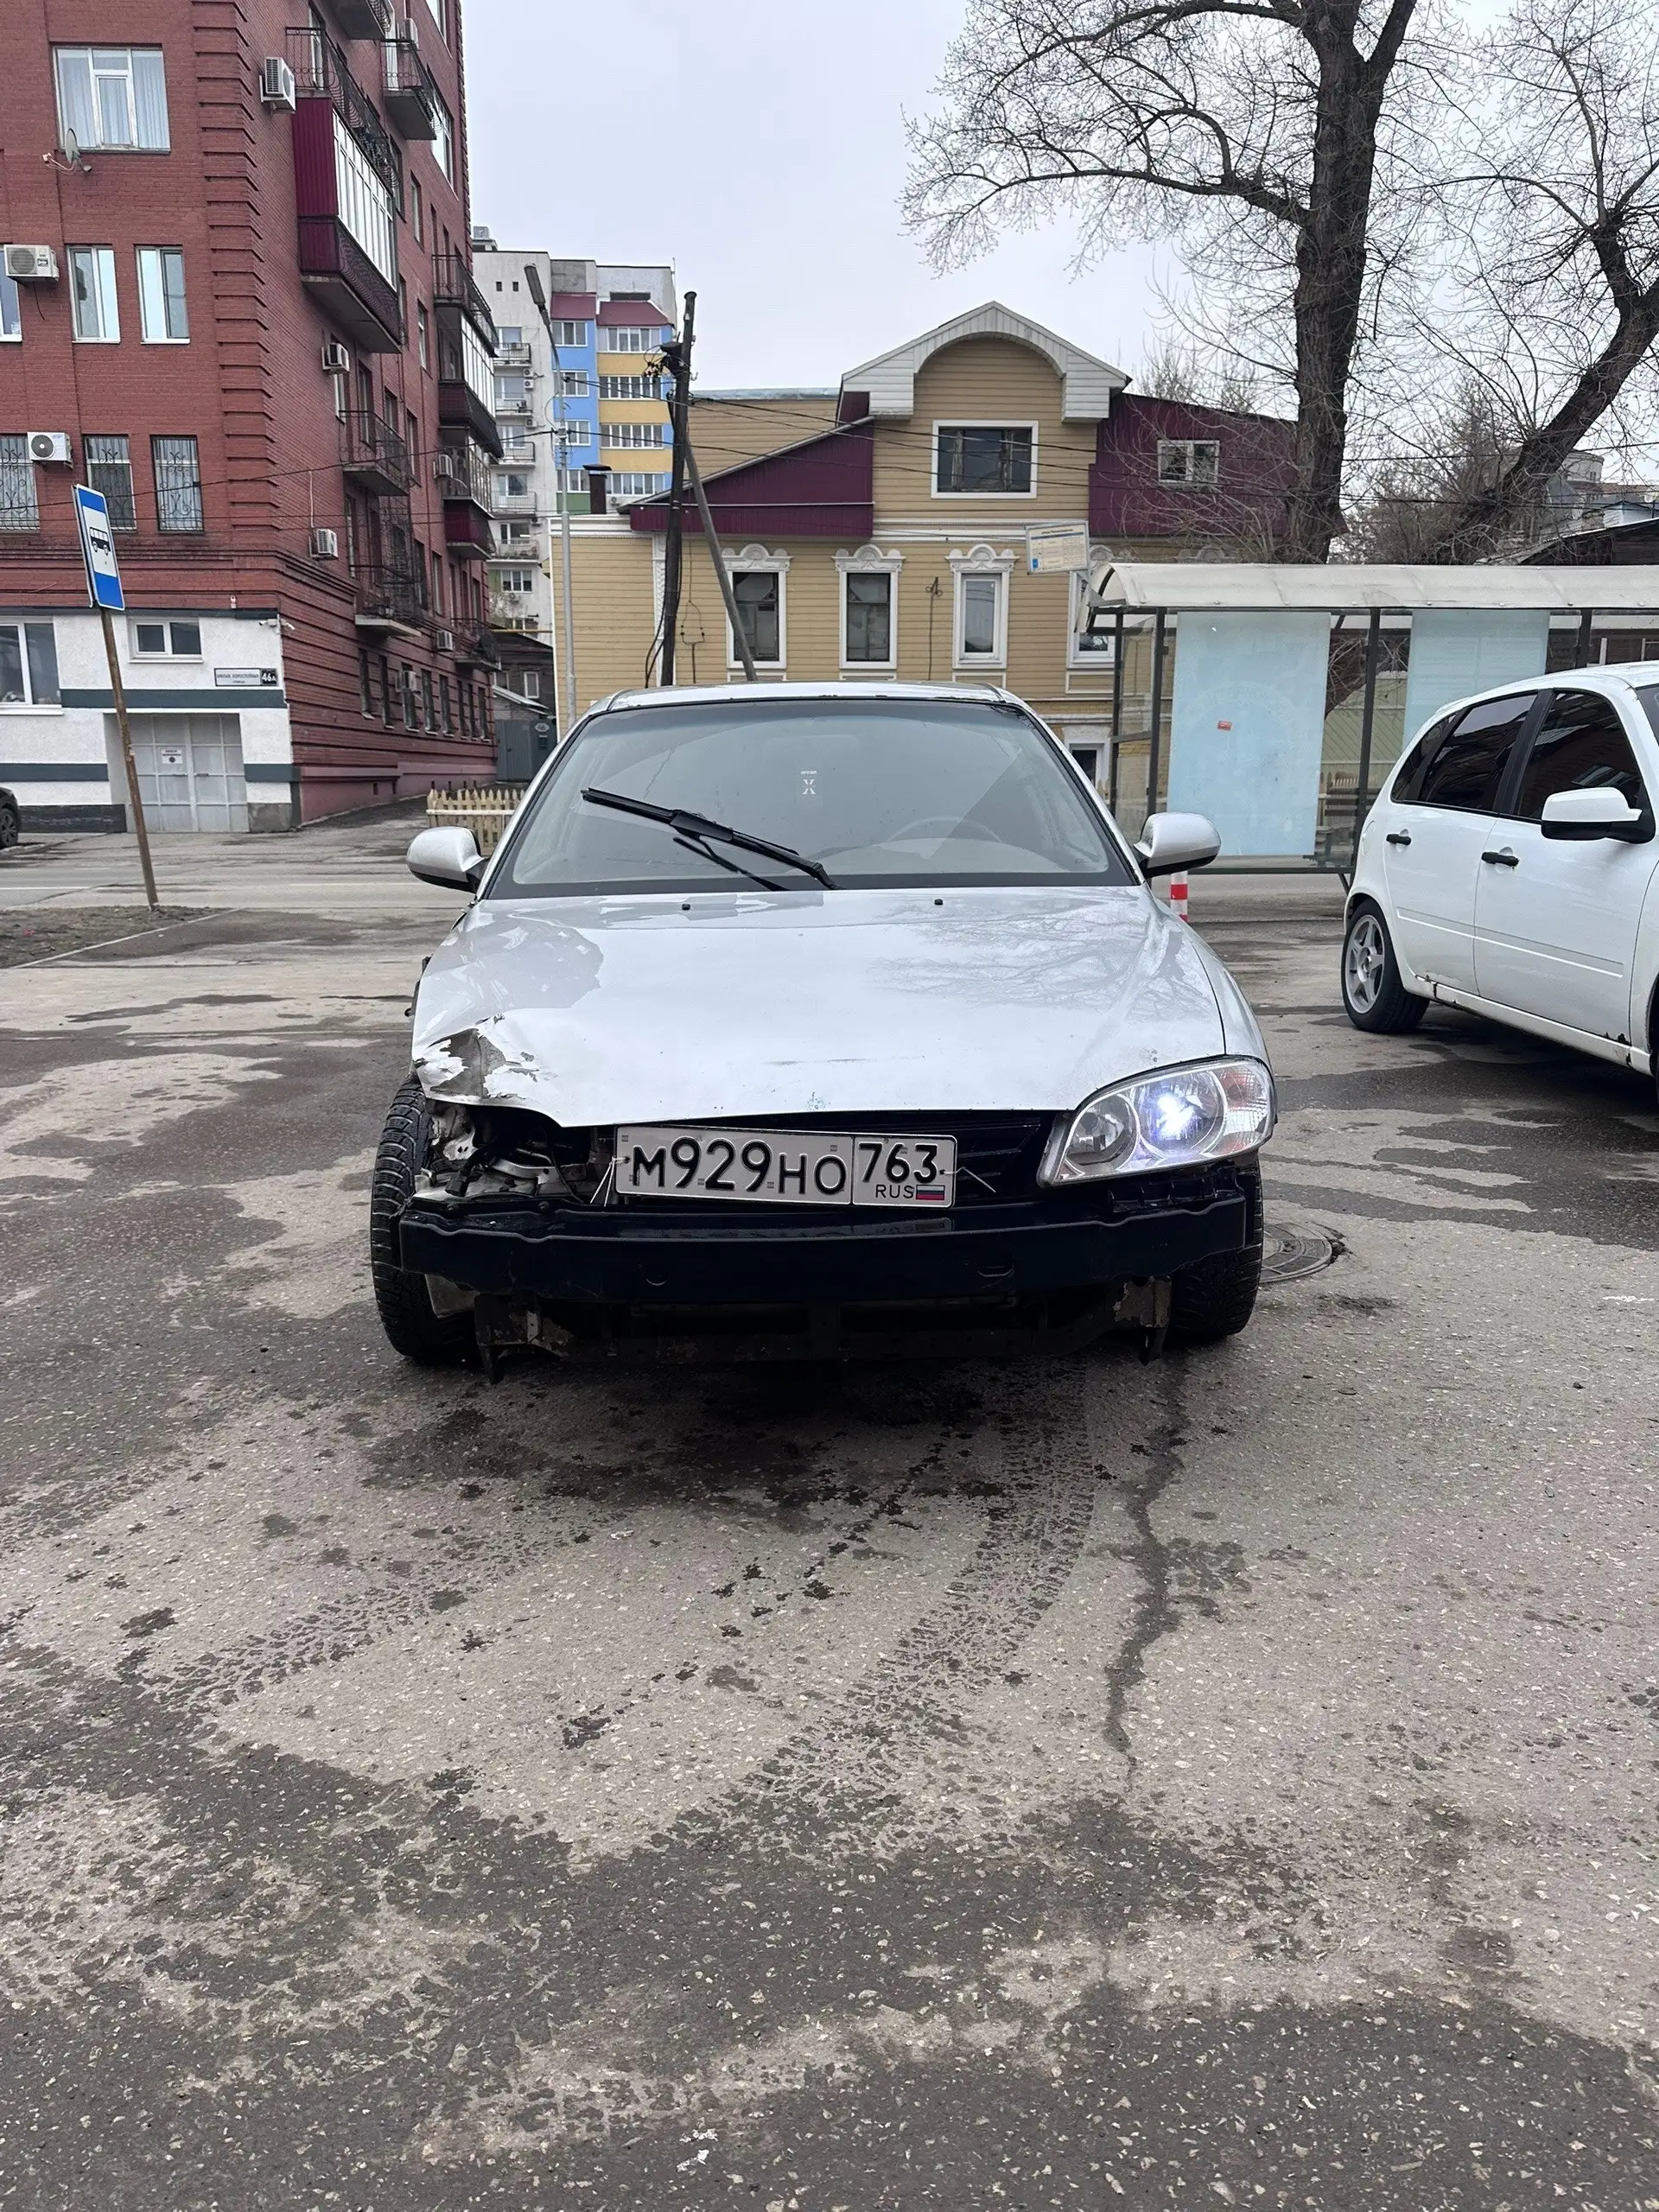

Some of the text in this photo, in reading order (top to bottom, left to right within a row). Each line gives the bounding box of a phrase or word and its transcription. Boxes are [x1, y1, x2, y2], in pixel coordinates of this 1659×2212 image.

[632, 1135, 938, 1195] М929НО 763
[875, 1185, 913, 1199] RUS
